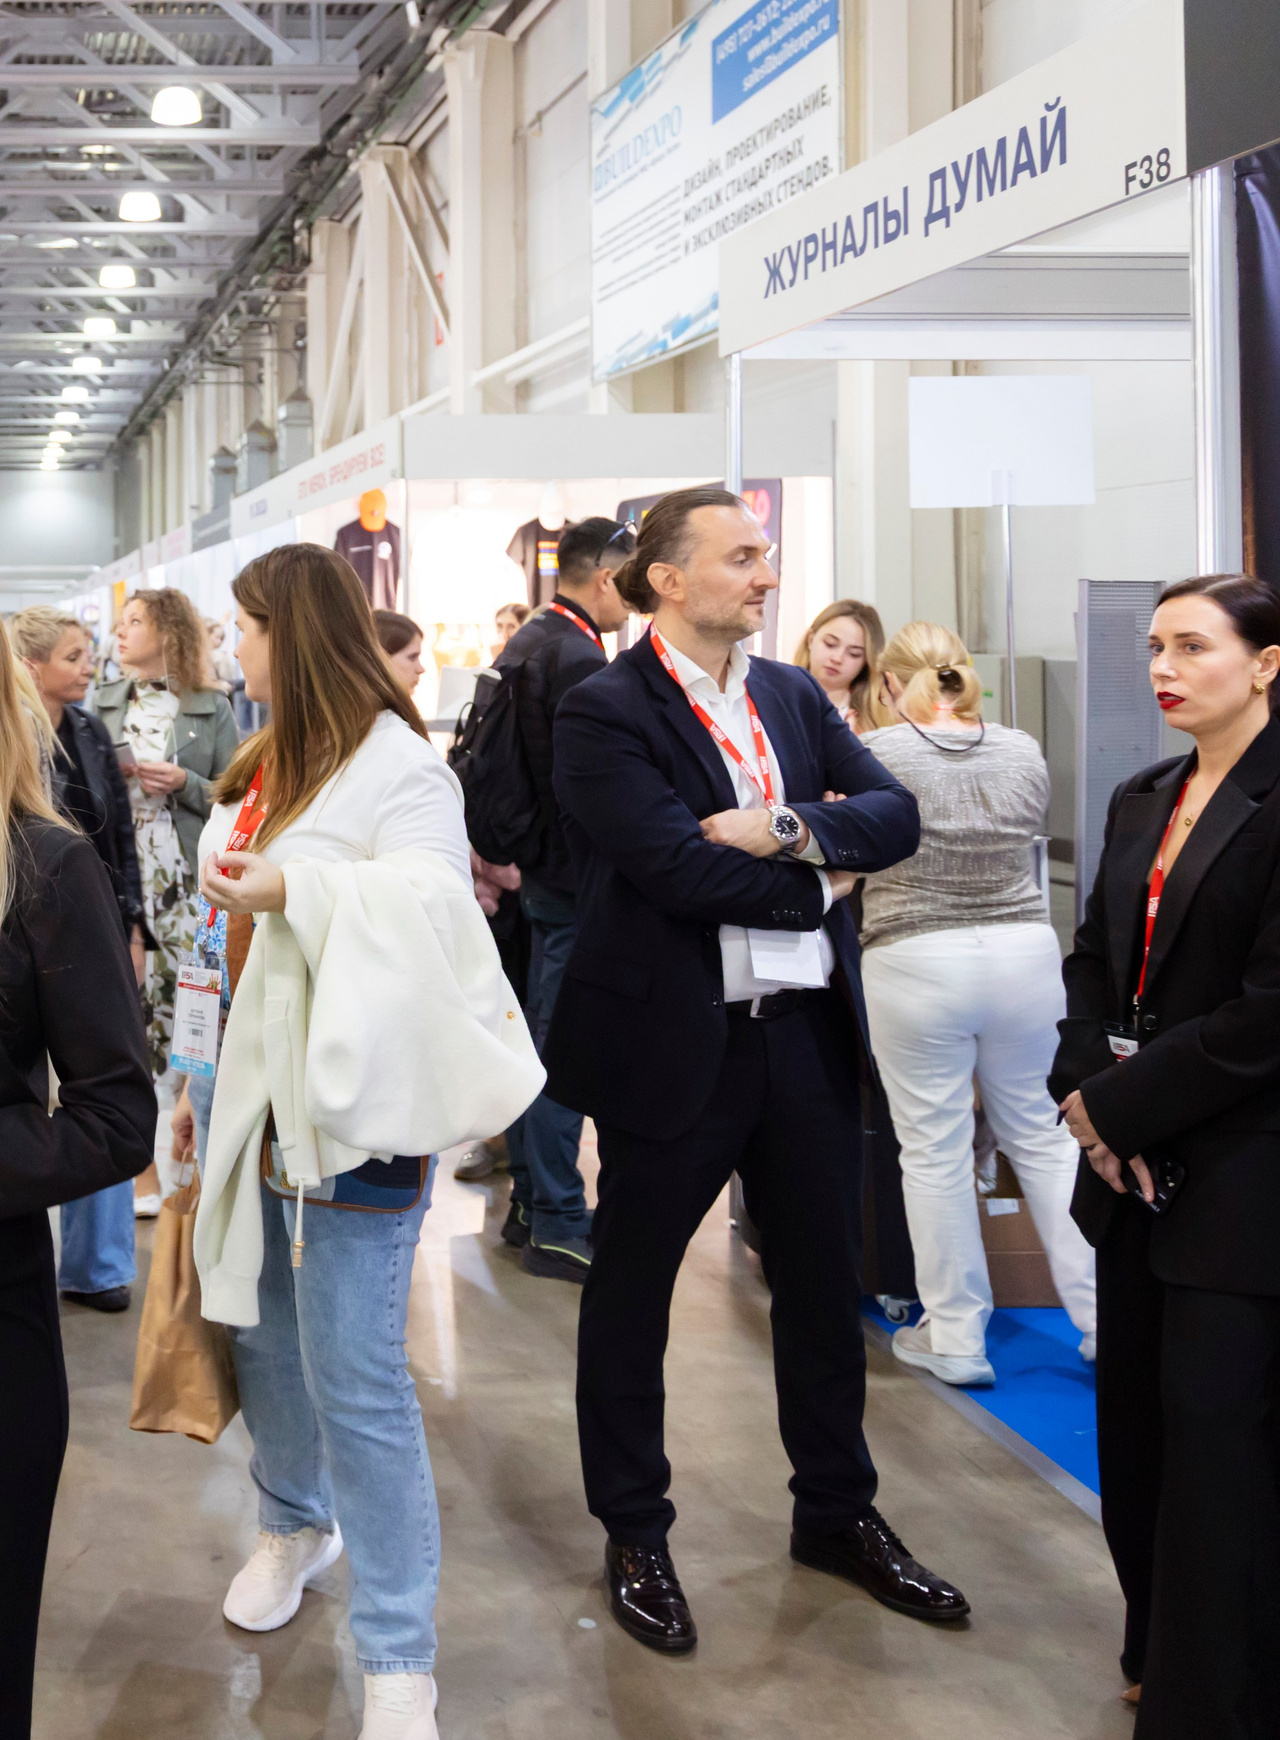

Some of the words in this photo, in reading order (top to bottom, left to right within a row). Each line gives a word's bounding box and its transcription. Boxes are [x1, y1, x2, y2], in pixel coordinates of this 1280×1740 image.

[684, 158, 723, 198] ДИЗАЙН,
[726, 84, 831, 170] ПРОЕКТИРОВАНИЕ,
[684, 190, 723, 226] МОНТАЖ
[725, 135, 804, 201] СТАНДАРТНЫХ
[1124, 147, 1171, 196] F38
[692, 188, 774, 253] ЭКСКЛЮЗИВНЫХ
[777, 155, 833, 203] СТЕНДОВ.
[763, 186, 909, 299] ЖУРНАЛЫ
[924, 96, 1067, 238] ДУМАЙ
